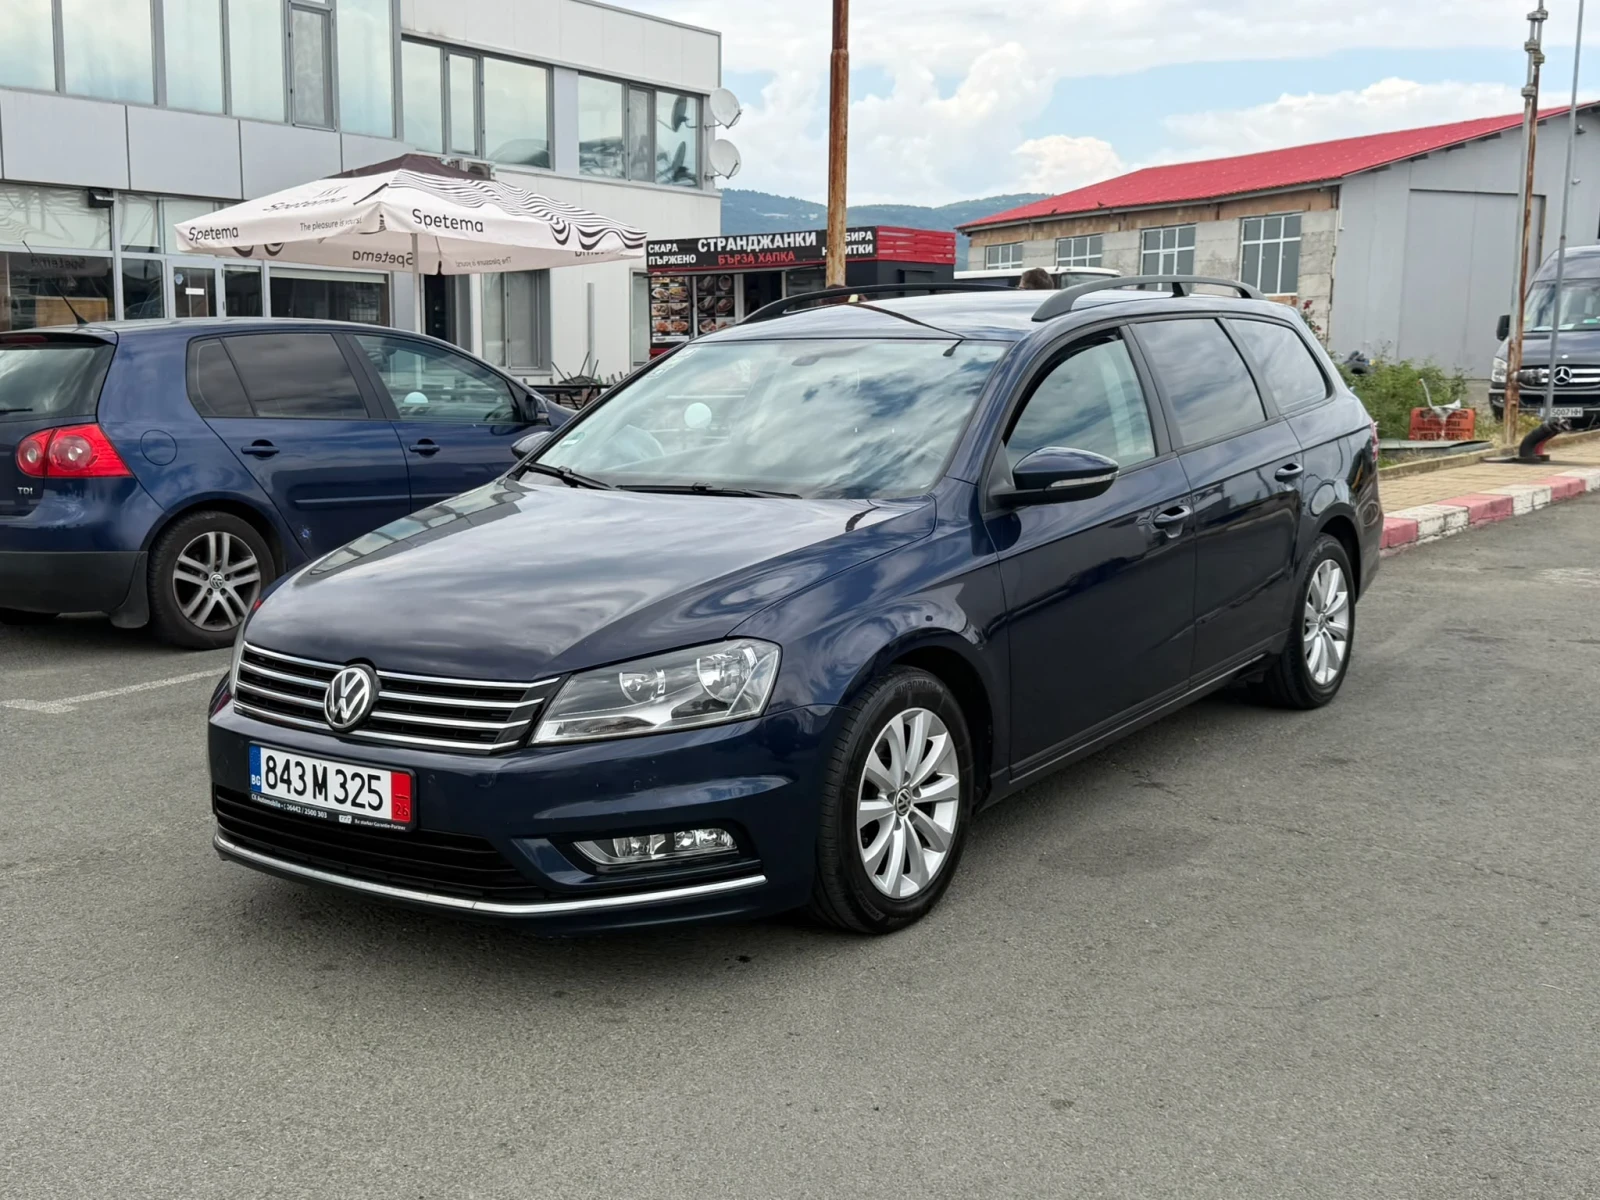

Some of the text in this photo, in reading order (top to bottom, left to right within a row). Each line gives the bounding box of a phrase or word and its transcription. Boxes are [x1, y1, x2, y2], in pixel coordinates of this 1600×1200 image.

[300, 222, 311, 231] The
[312, 220, 339, 232] pleasure
[339, 218, 345, 227] is
[412, 208, 484, 233] Spetema
[188, 226, 239, 244] Spetema
[845, 231, 873, 243] БИРА
[648, 243, 679, 254] СКАРА
[698, 232, 817, 253] СТРАНДЖАНКИ
[821, 244, 873, 257] НИТКИ
[648, 254, 697, 266] ПЪРЖЕНО
[717, 250, 796, 266] БЪРЗА ХАПКА
[17, 486, 33, 495] TDI
[251, 774, 261, 786] BG
